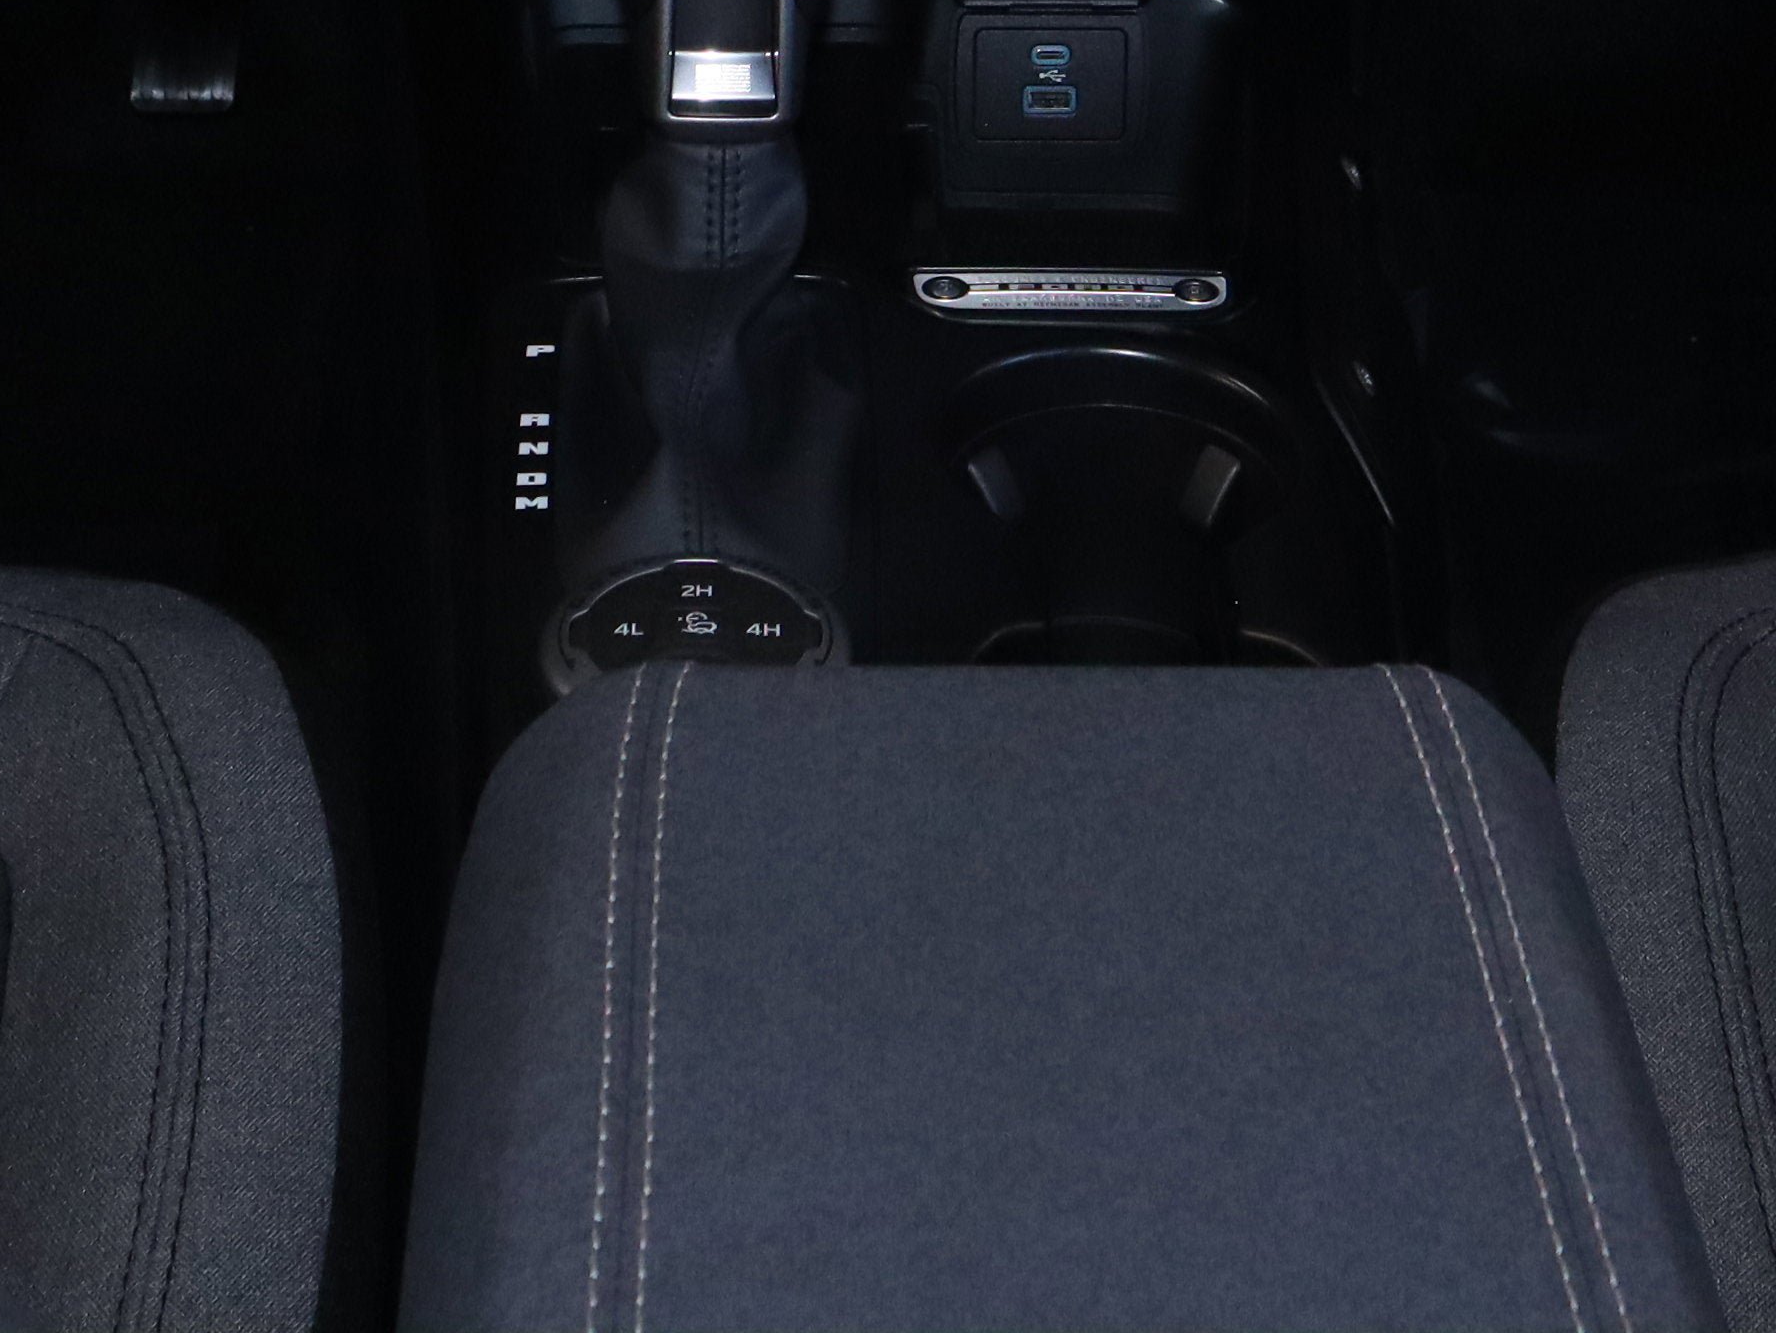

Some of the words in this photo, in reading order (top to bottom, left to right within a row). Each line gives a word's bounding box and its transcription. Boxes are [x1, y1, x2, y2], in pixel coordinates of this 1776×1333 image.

[525, 344, 556, 357] P
[520, 413, 550, 427] R
[518, 441, 549, 455] N
[516, 472, 547, 486] D
[515, 496, 549, 510] M
[680, 584, 713, 598] 2H
[613, 622, 644, 636] 4L
[745, 623, 782, 637] 4H
